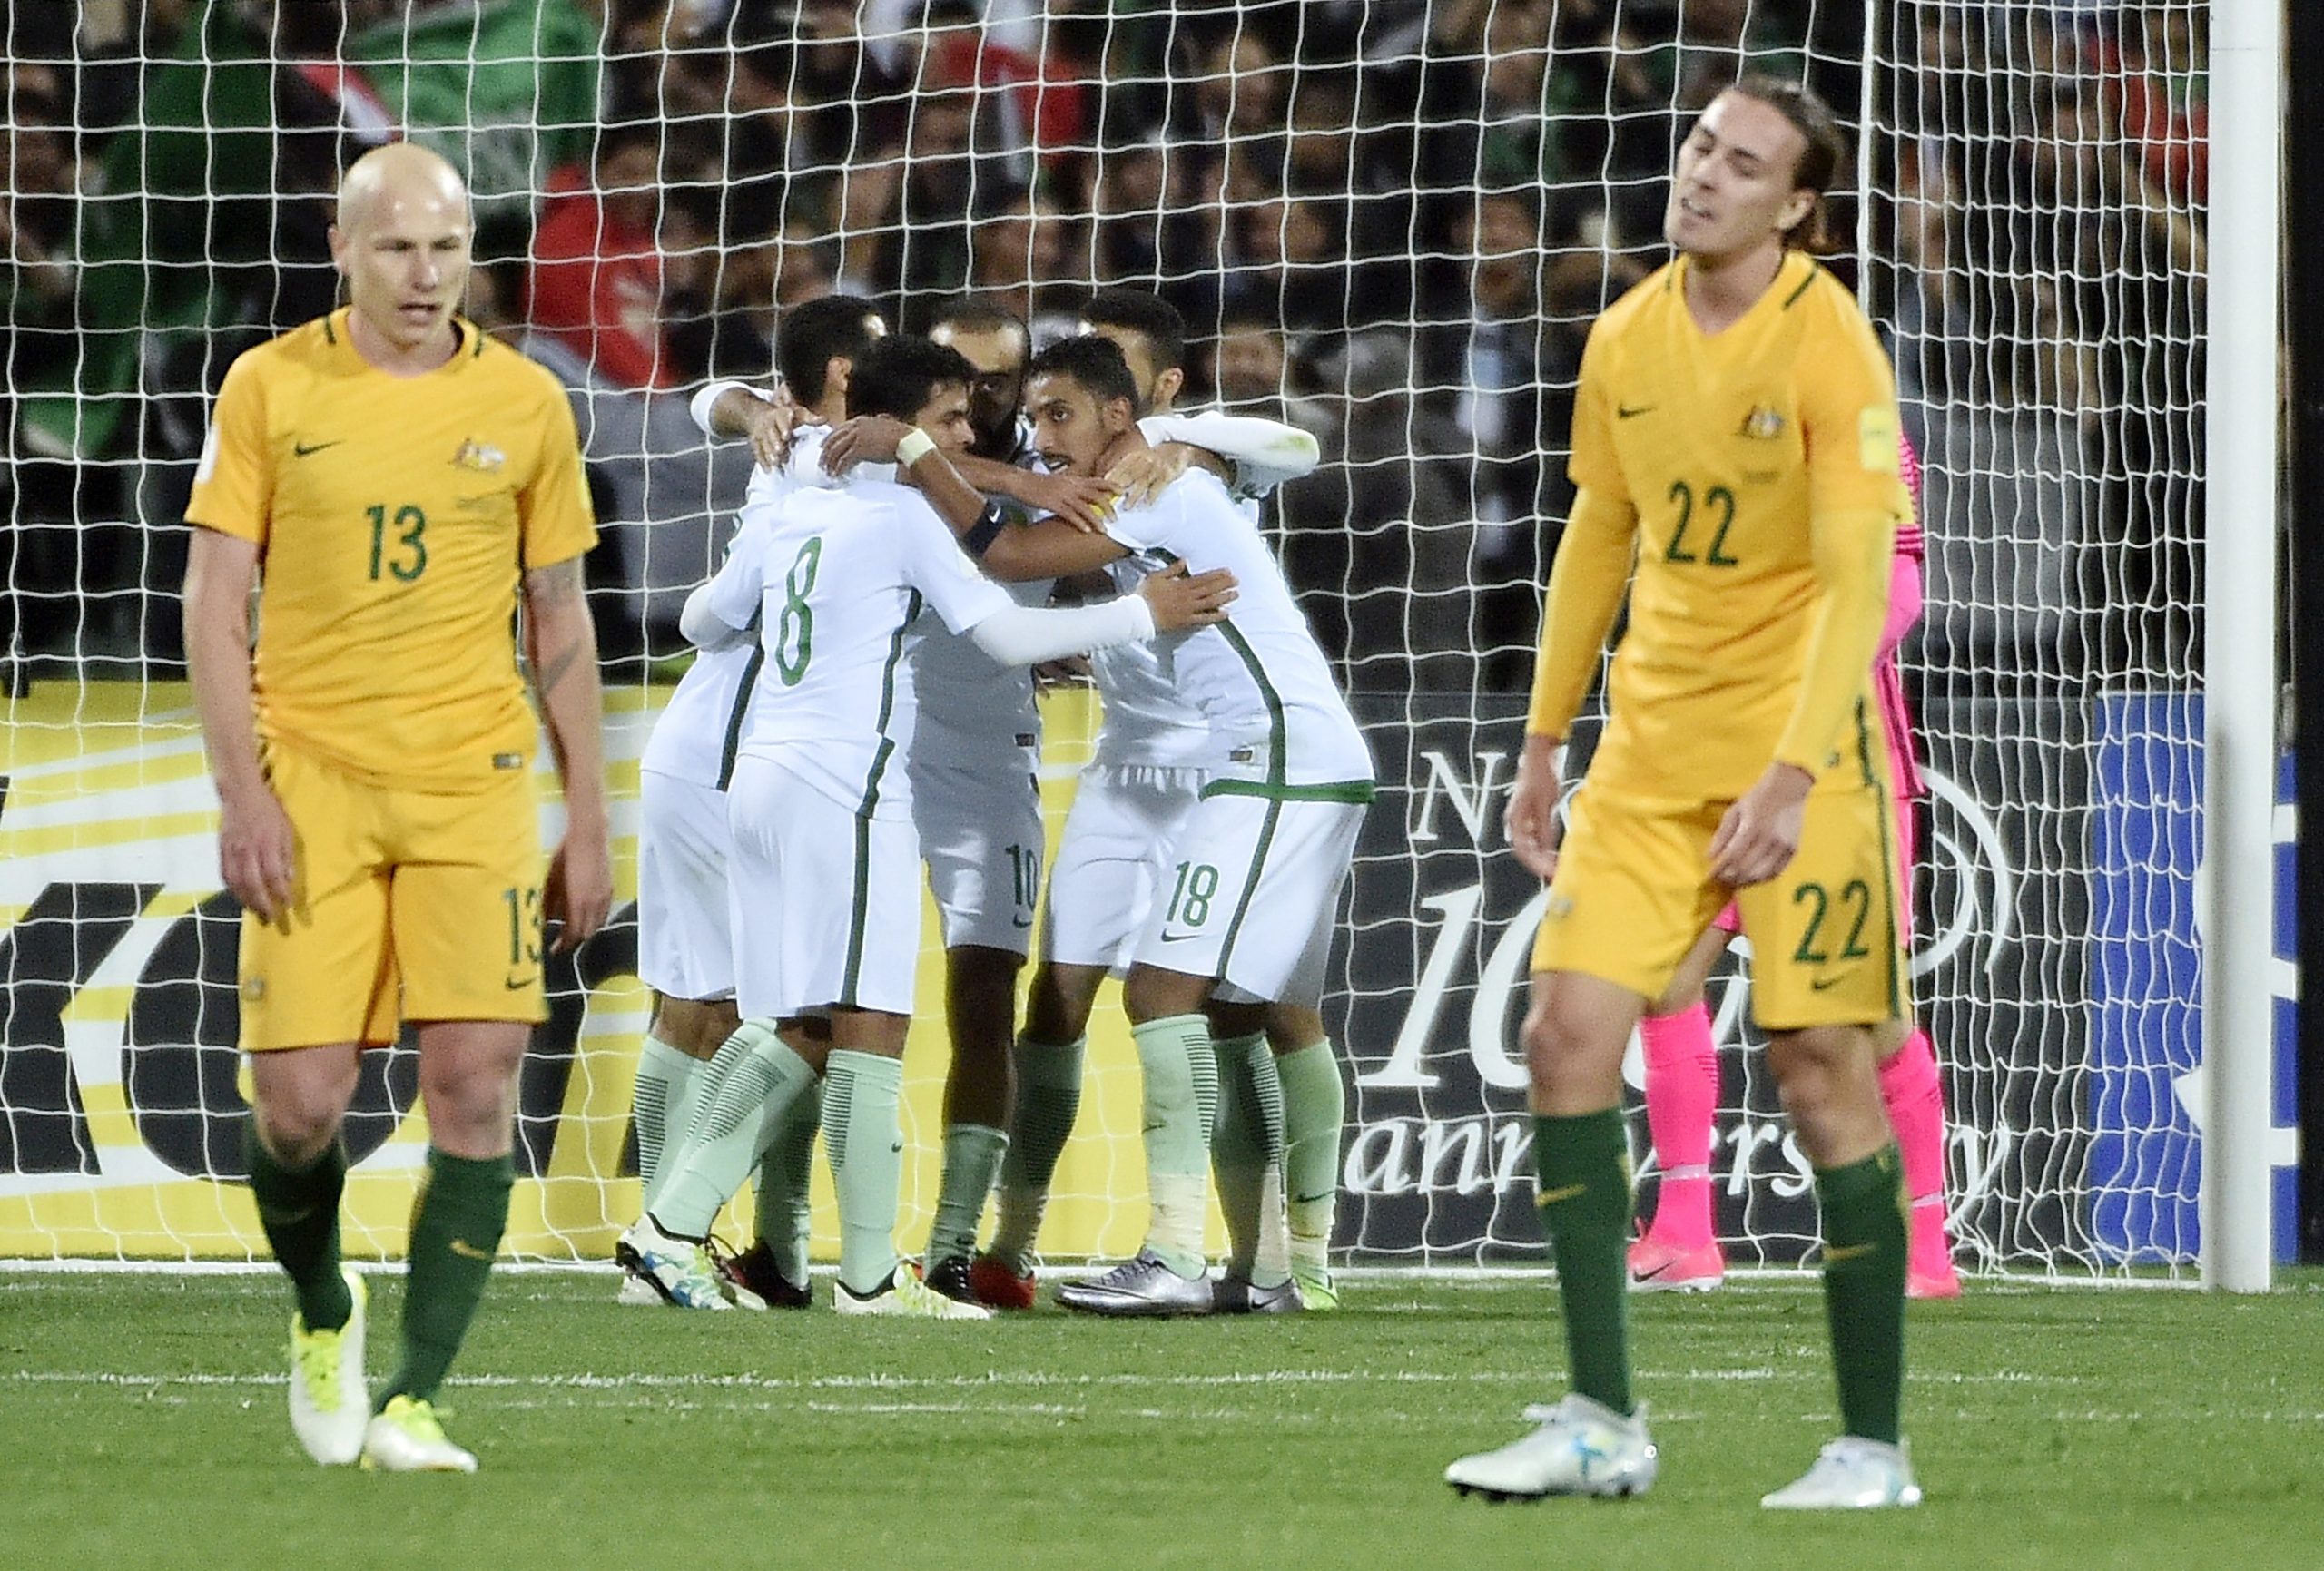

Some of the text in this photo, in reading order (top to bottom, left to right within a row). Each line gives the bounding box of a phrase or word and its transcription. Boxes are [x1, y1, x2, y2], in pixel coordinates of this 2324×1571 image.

[366, 505, 427, 581] 13
[1665, 480, 1739, 566] 22
[775, 536, 822, 686] 8
[1005, 844, 1039, 912] 10
[1166, 860, 1219, 927] 18
[1792, 879, 1870, 963] 22
